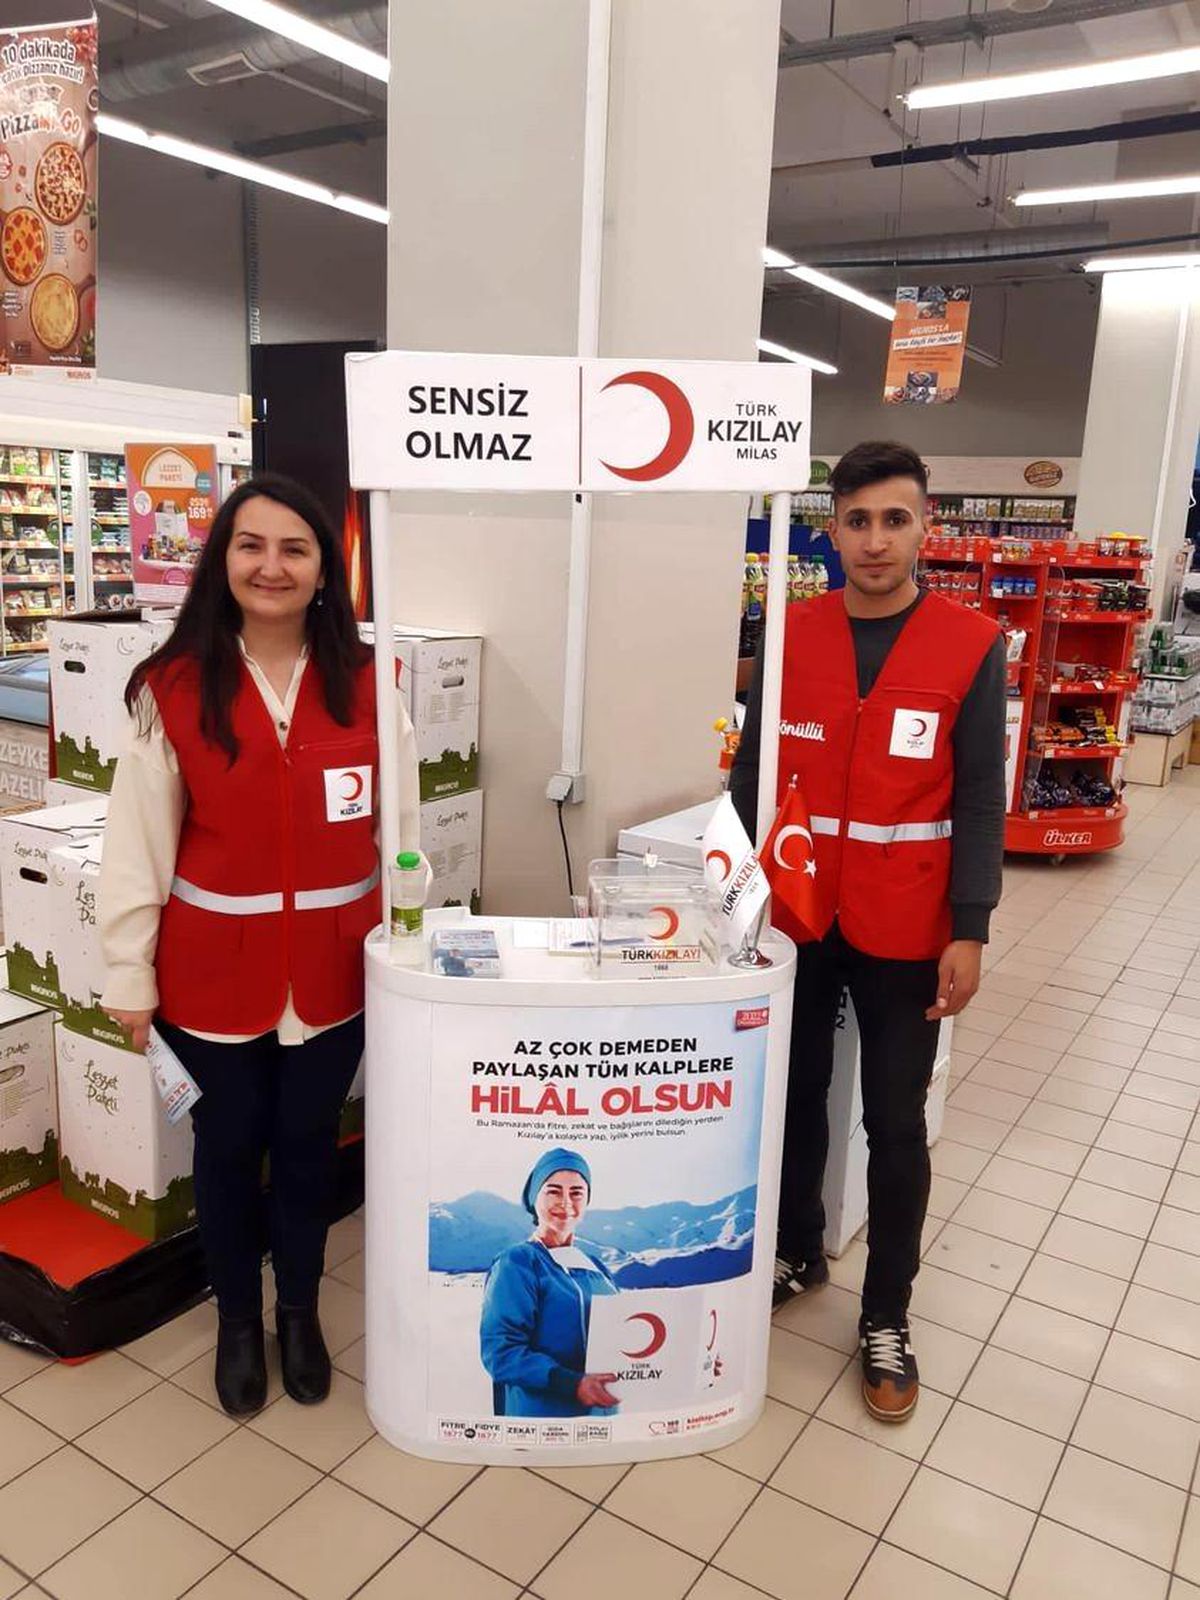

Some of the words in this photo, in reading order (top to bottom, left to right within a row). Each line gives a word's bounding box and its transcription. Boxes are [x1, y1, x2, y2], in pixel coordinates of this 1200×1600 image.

[3, 45, 17, 65] 10
[20, 40, 76, 61] dakikada
[408, 382, 529, 418] SENSİZ
[736, 401, 777, 417] TÜRK
[708, 420, 802, 443] KIZILAY
[406, 431, 532, 461] OLMAZ
[737, 446, 777, 460] MİLAS
[779, 719, 826, 741] önüllü
[1043, 829, 1092, 846] ÜLKER
[514, 1041, 542, 1056] AZ
[549, 1041, 593, 1059] ÇOK
[600, 1038, 697, 1056] DEMEDEN
[472, 1061, 579, 1081] PAYLAŞAN
[585, 1060, 628, 1078] TÜM
[635, 1057, 734, 1076] KALPLERE
[601, 1080, 733, 1117] OLSUN
[476, 1119, 489, 1127] Bu
[491, 1119, 545, 1129] Ramazan'da
[571, 1122, 595, 1130] zekat
[556, 1132, 588, 1141] kolayca
[617, 1369, 663, 1381] KIZILAY
